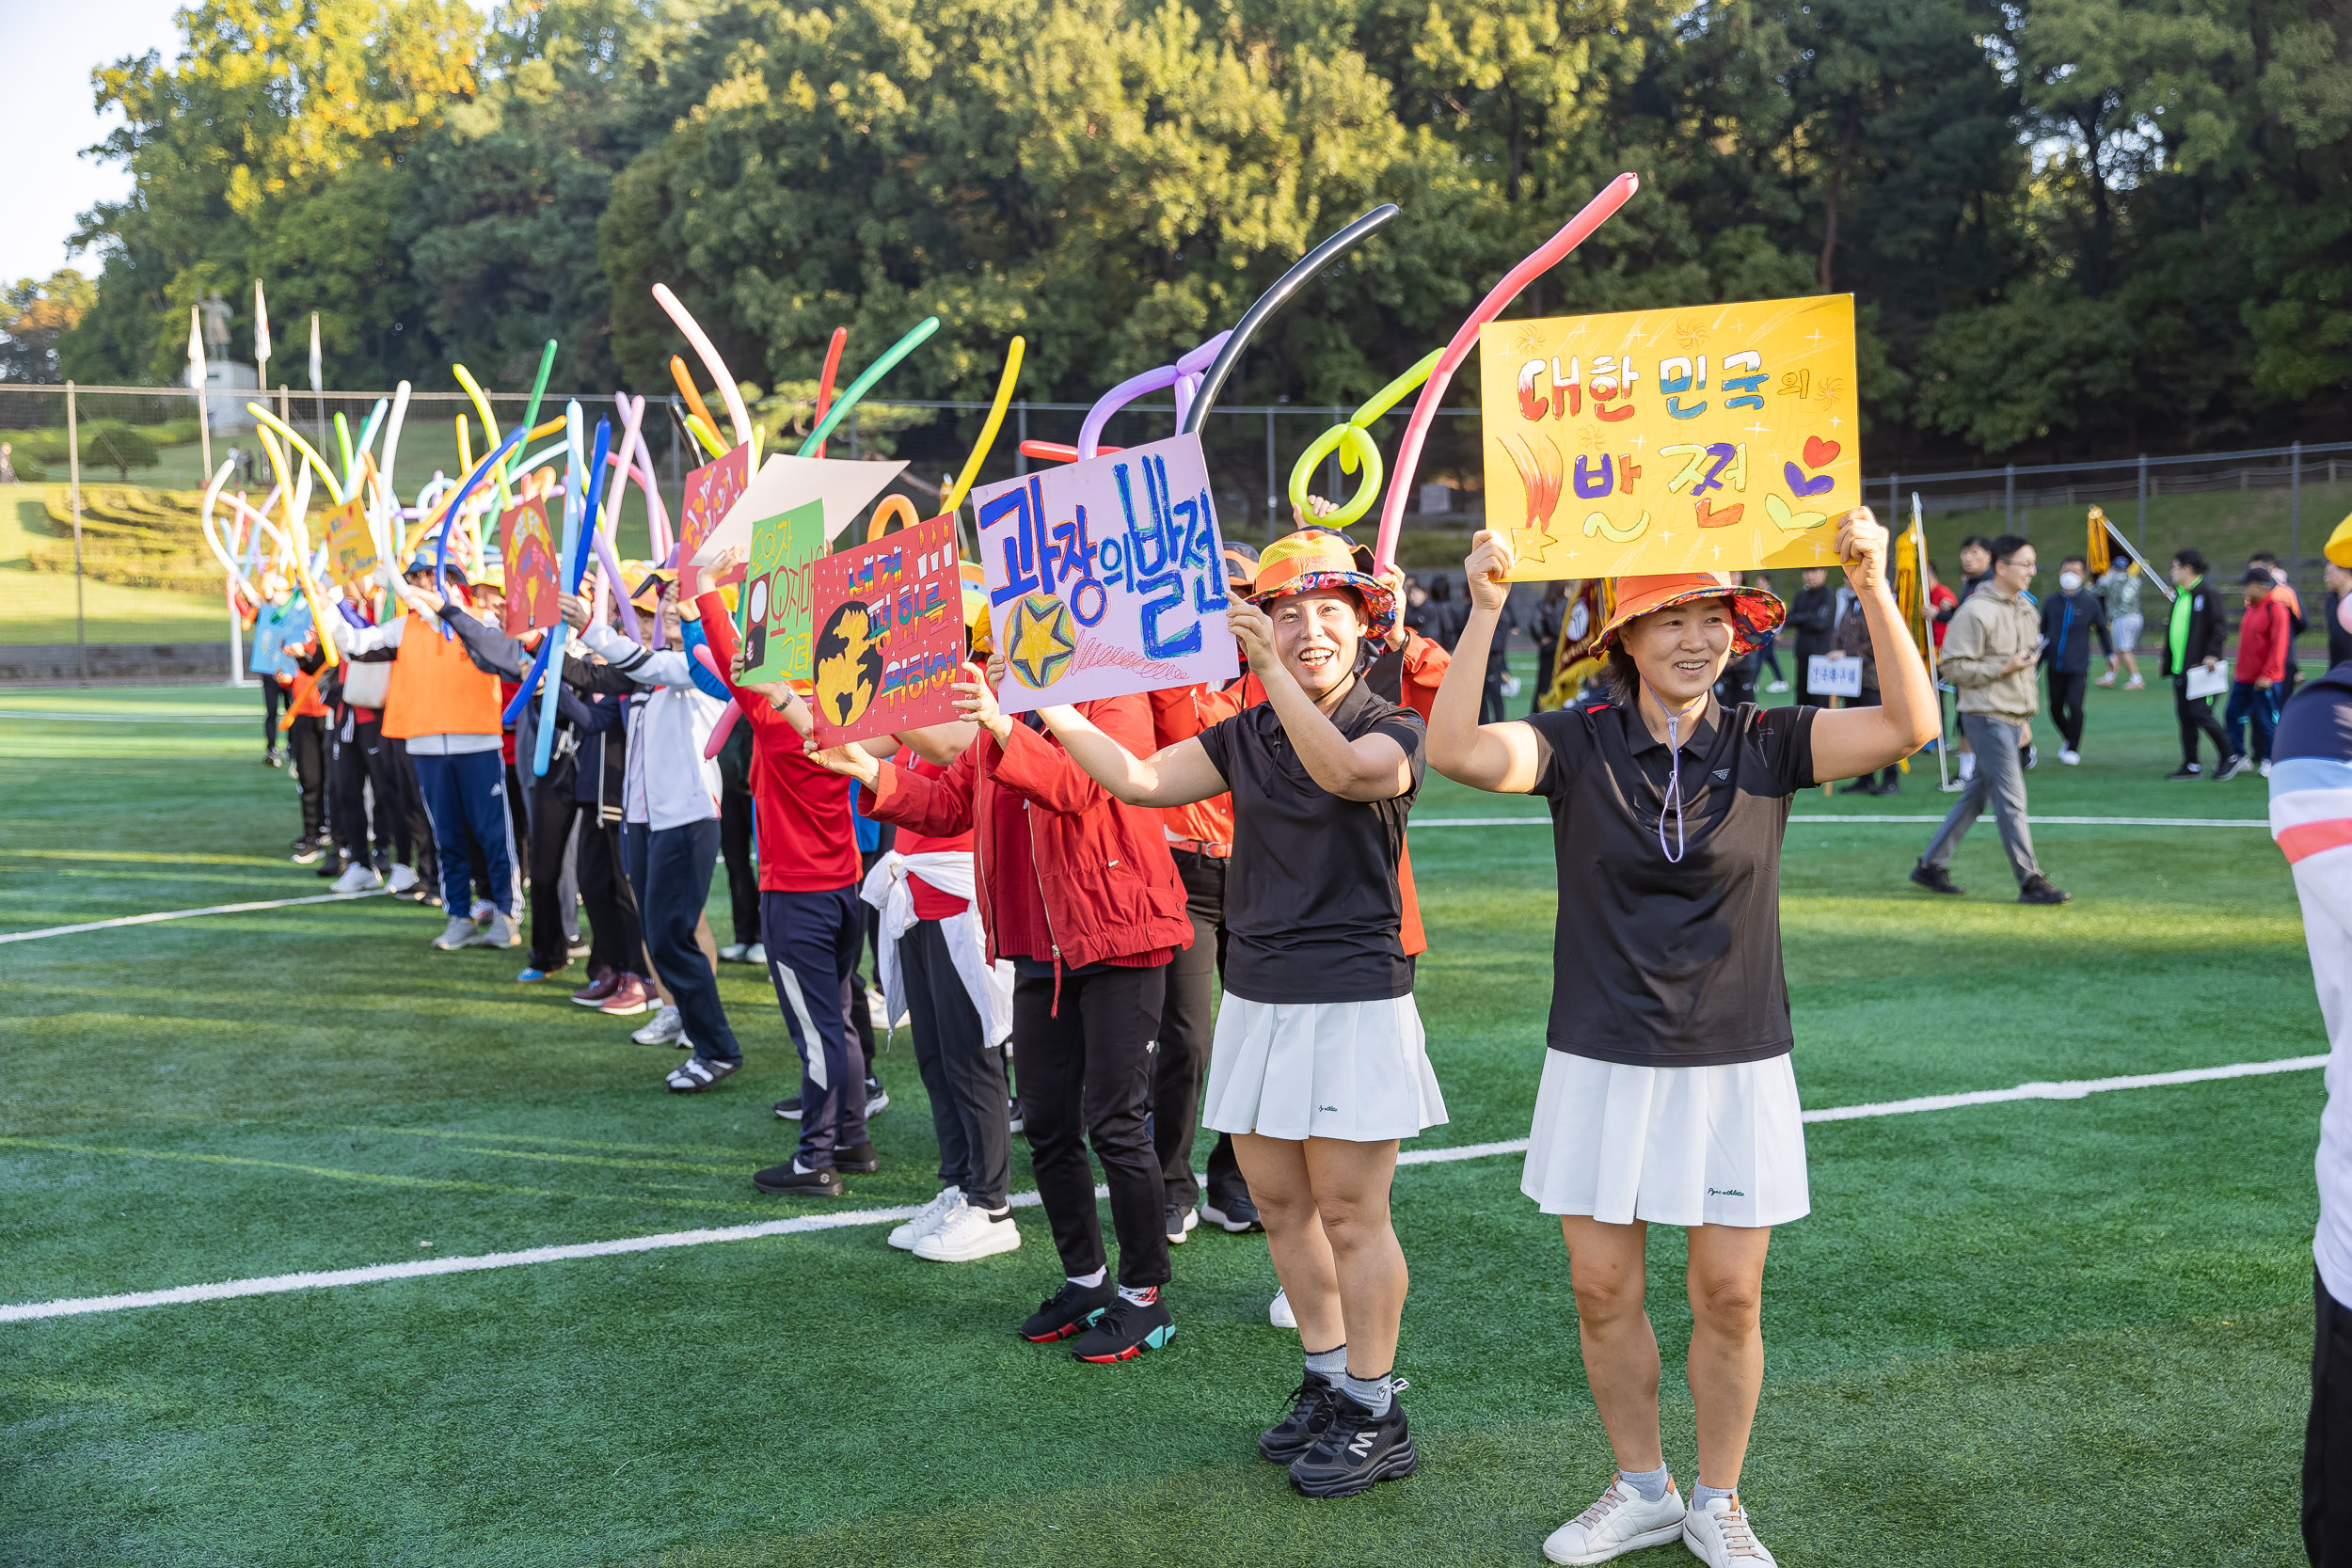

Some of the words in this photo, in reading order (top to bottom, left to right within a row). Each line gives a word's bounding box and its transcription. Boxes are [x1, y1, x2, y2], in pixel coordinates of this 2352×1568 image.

[849, 545, 902, 600] 세계
[866, 581, 949, 657] 평화를
[881, 641, 957, 713] 위하여
